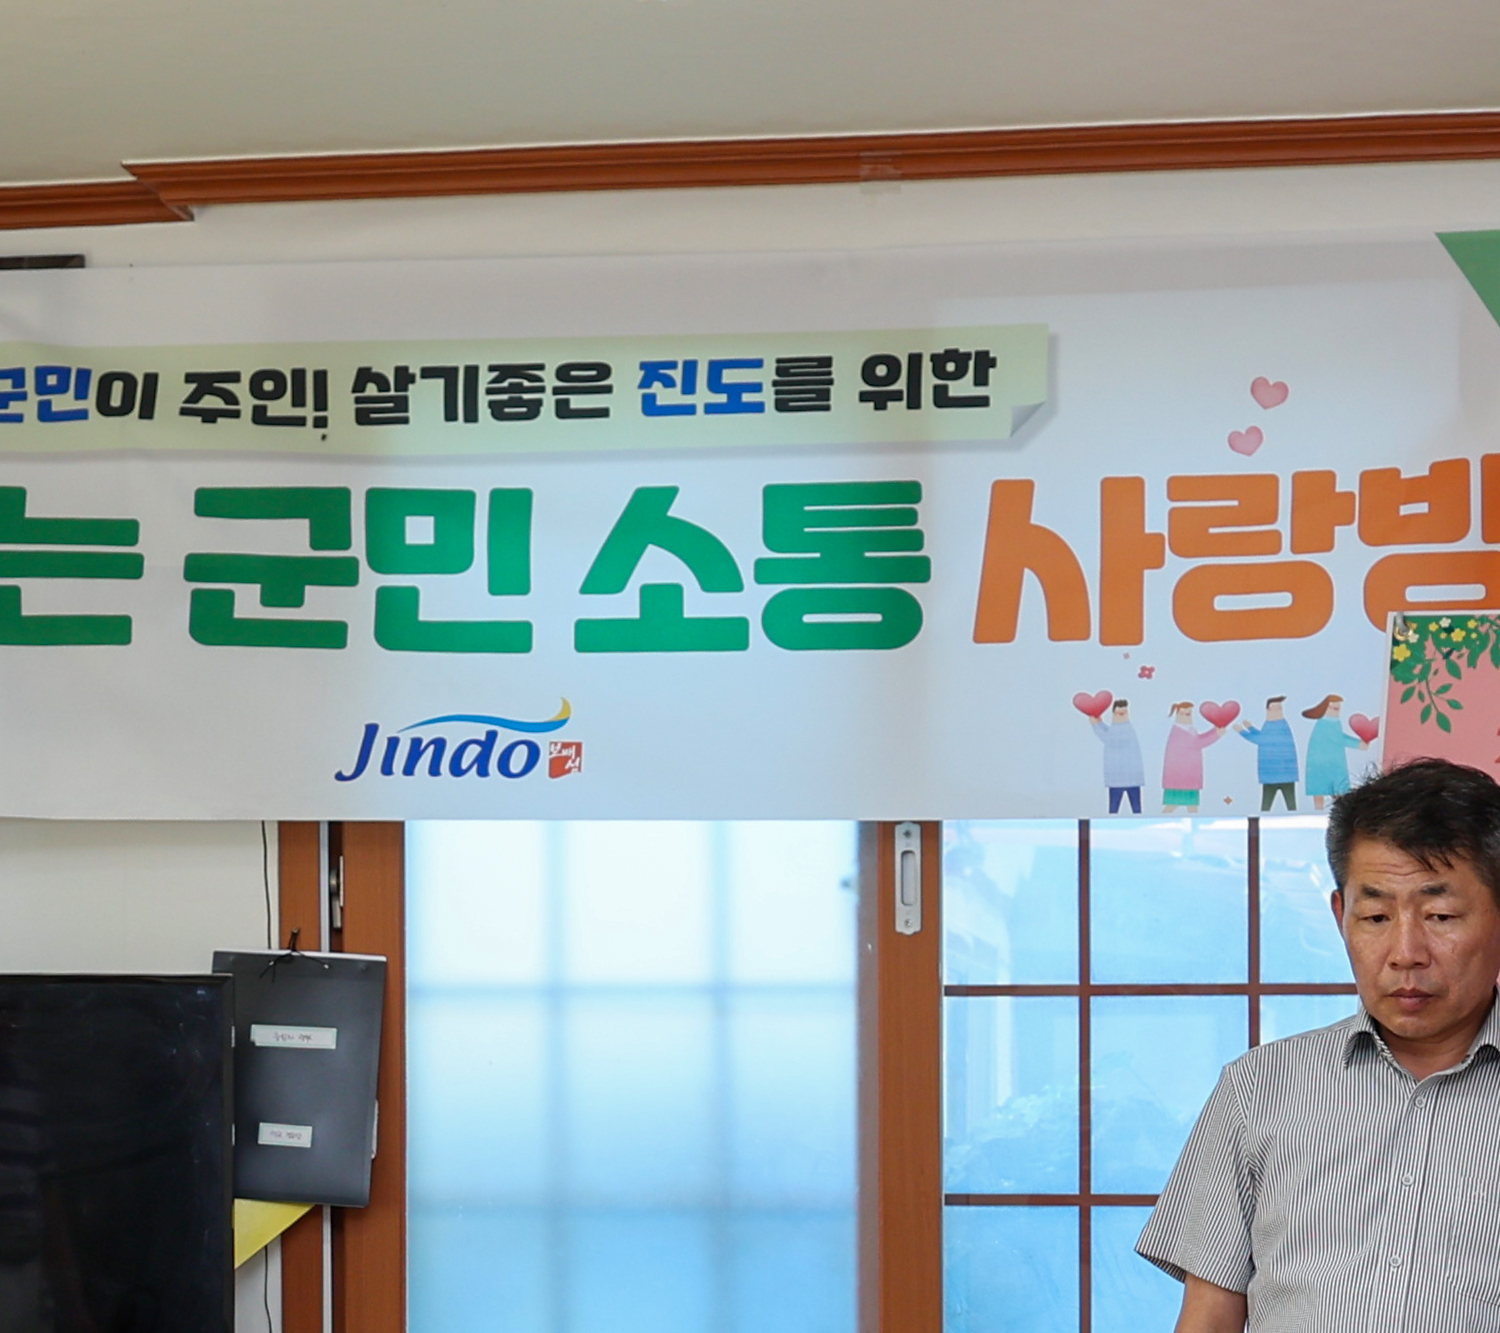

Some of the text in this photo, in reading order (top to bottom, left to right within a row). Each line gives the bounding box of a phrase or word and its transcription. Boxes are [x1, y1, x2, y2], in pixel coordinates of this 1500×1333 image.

[178, 364, 330, 428] 주인!
[351, 359, 613, 424] 살기좋은
[637, 352, 835, 417] 진도를
[859, 346, 997, 412] 위한
[183, 486, 534, 653] 군민
[573, 480, 932, 652] 소통
[334, 722, 541, 782] Jindo
